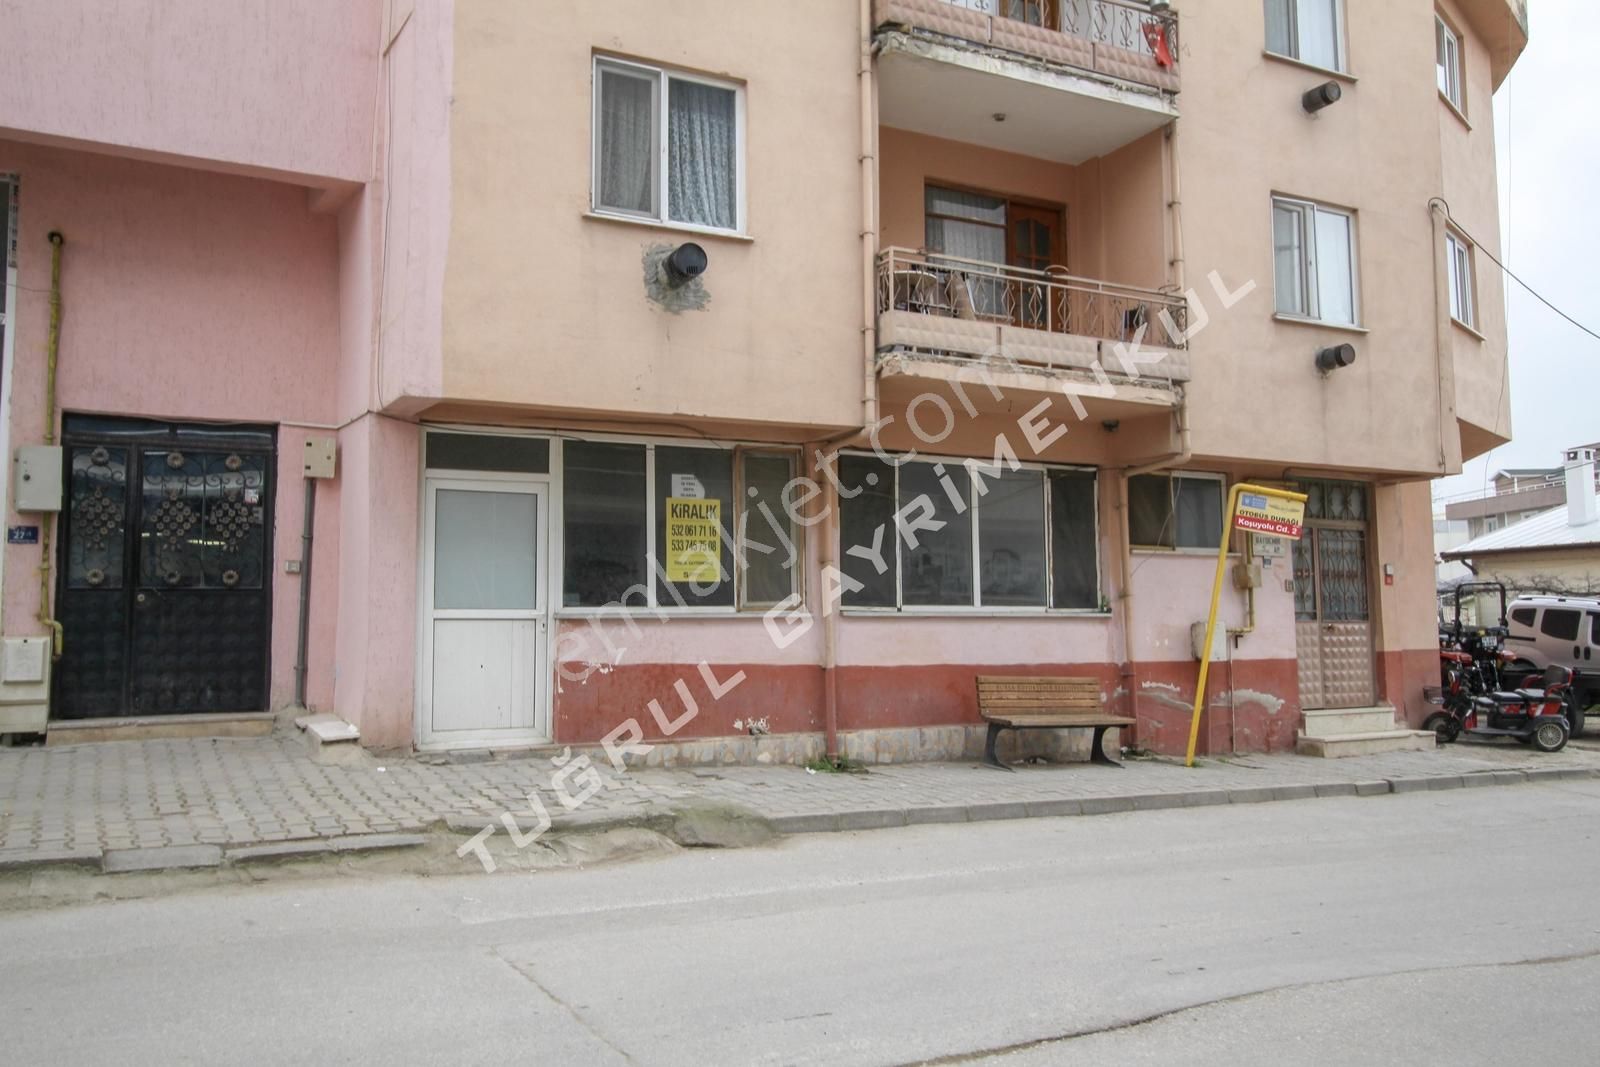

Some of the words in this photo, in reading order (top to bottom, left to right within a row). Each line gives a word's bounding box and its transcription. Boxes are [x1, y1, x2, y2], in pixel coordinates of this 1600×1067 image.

[671, 524, 683, 537] 532
[684, 524, 697, 537] 061
[699, 524, 707, 537] 71
[1238, 517, 1275, 531] Koşuyolu
[1275, 523, 1290, 534] Cd.
[1291, 527, 1298, 535] 2
[671, 539, 684, 552] 533
